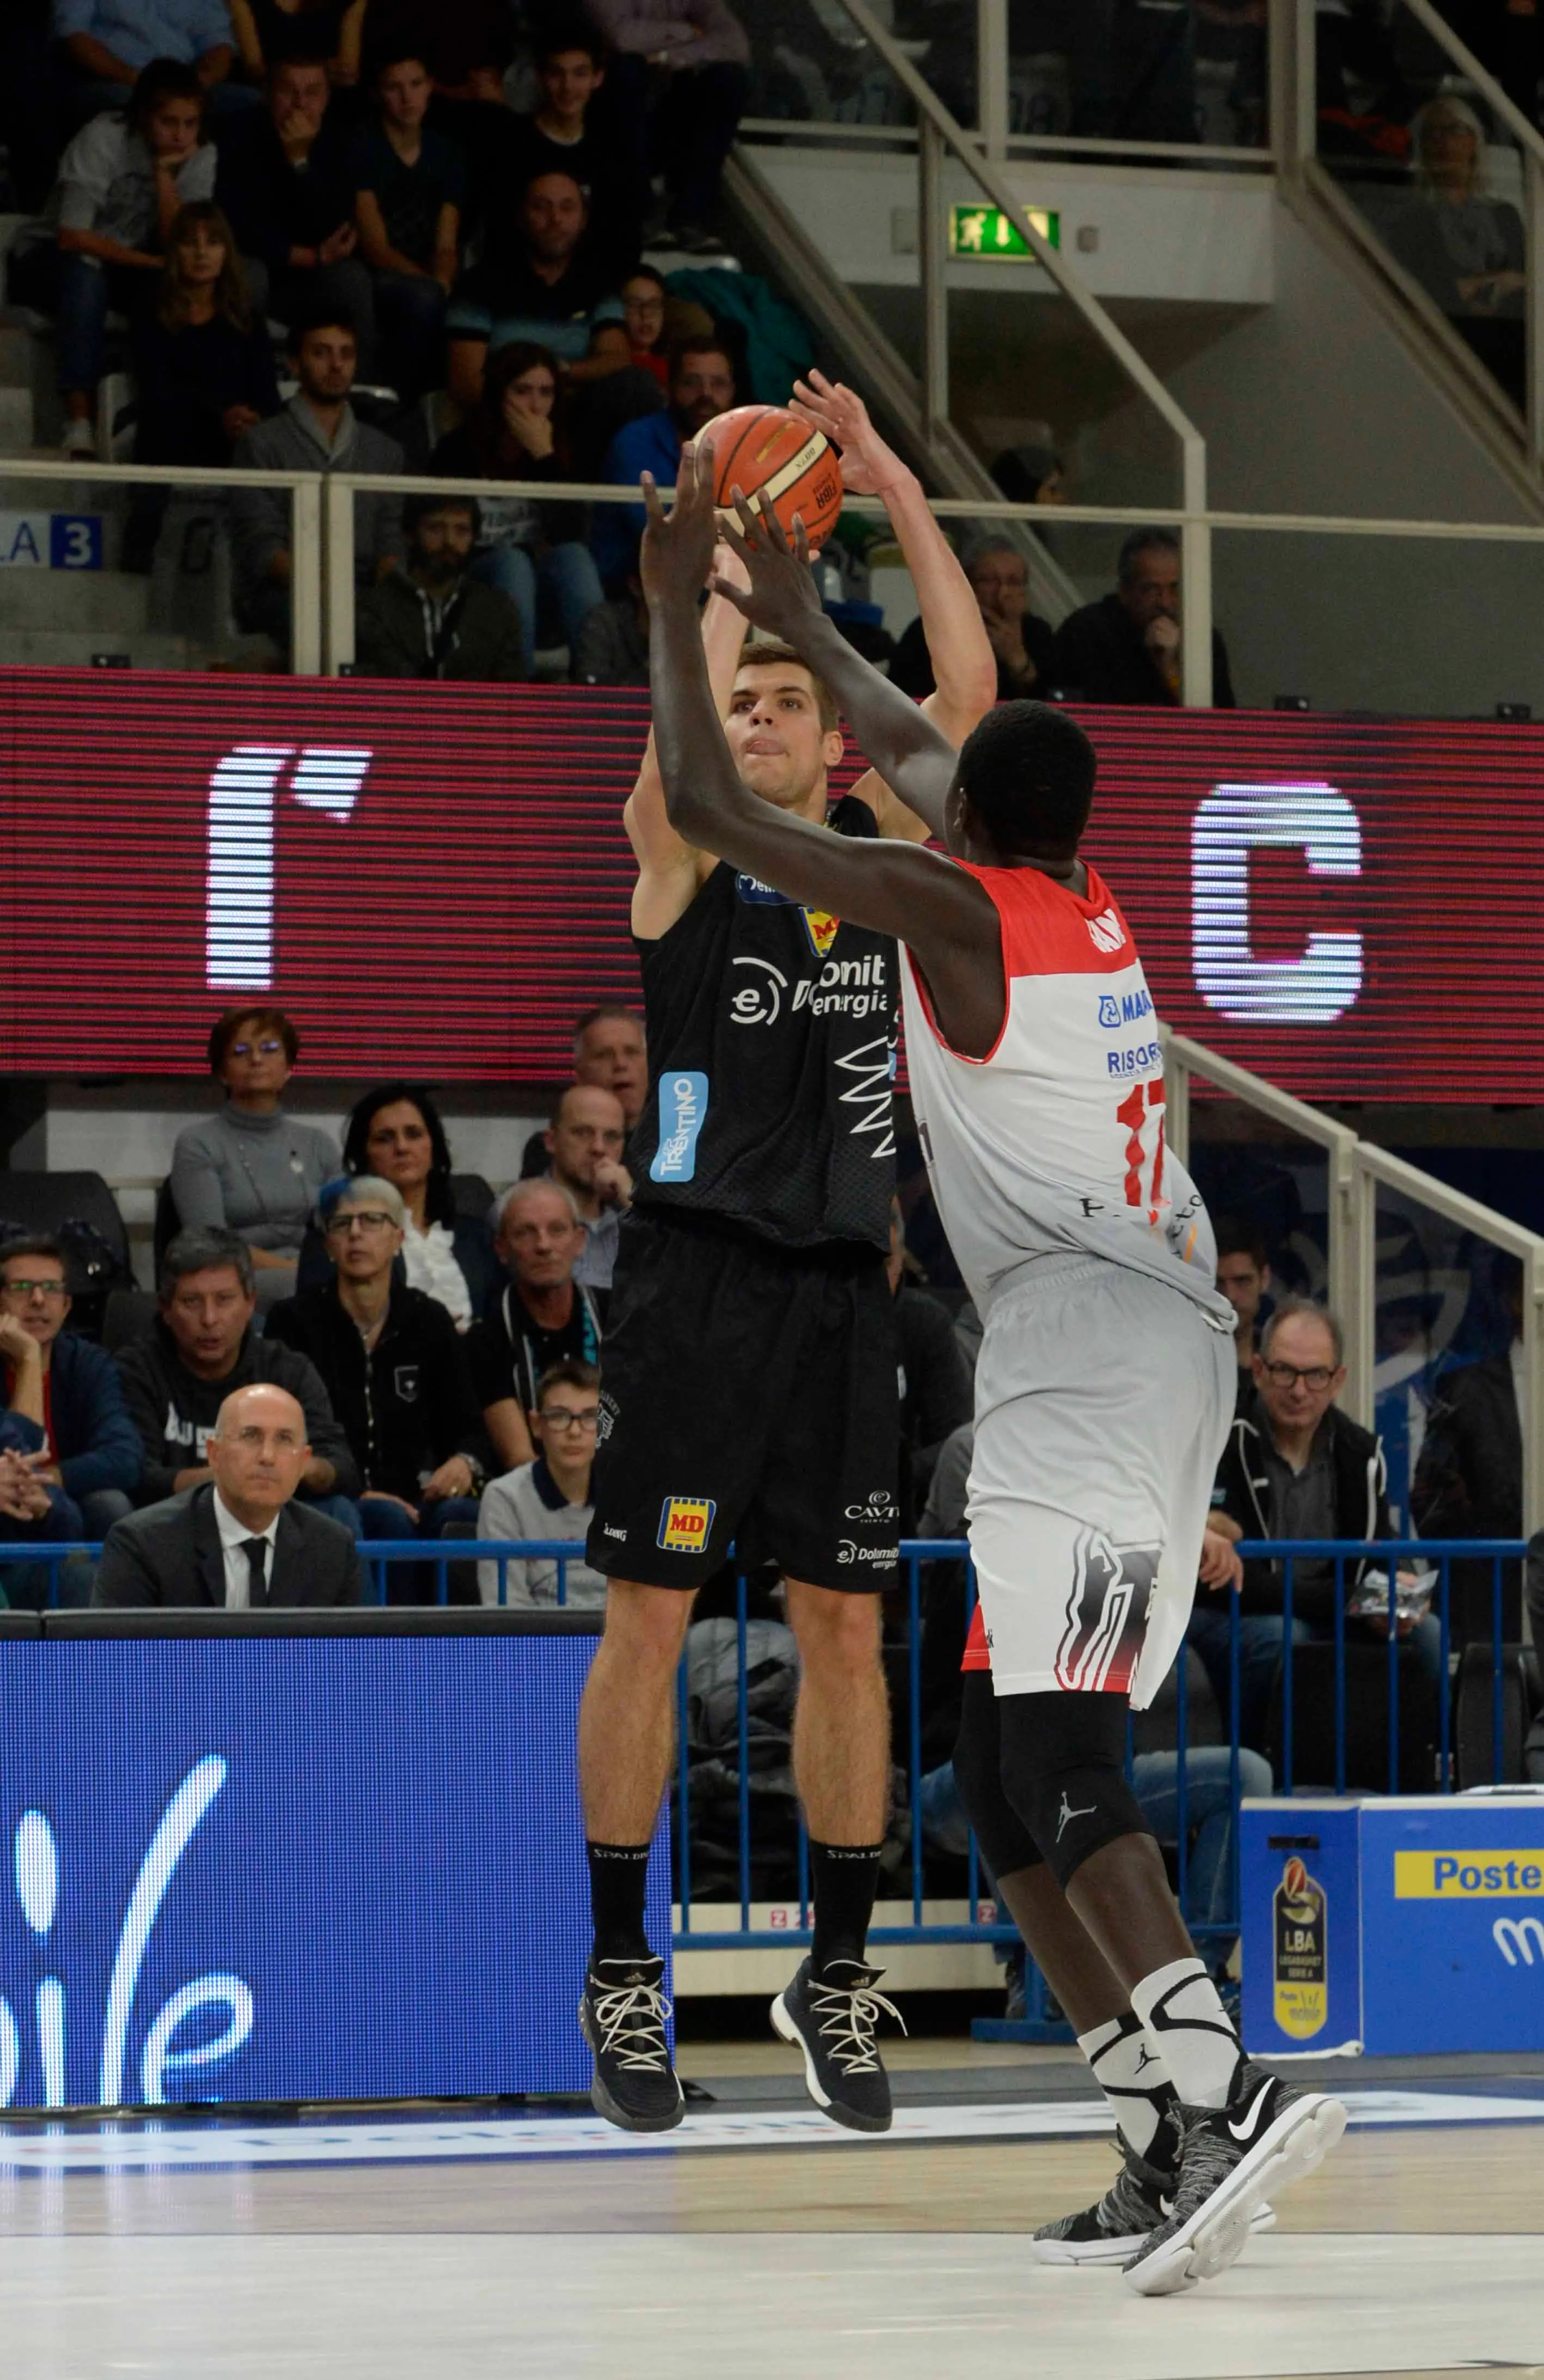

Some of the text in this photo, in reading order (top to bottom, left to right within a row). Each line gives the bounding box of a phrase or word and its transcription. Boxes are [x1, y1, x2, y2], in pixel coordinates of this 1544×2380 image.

[64, 522, 93, 565] 3
[1191, 782, 1363, 1020] C
[660, 1078, 697, 1176] TRENTINO
[1116, 1077, 1167, 1207] 17
[670, 1514, 705, 1534] MD
[1433, 1856, 1542, 1890] Poste
[1285, 1930, 1316, 1951] LBA
